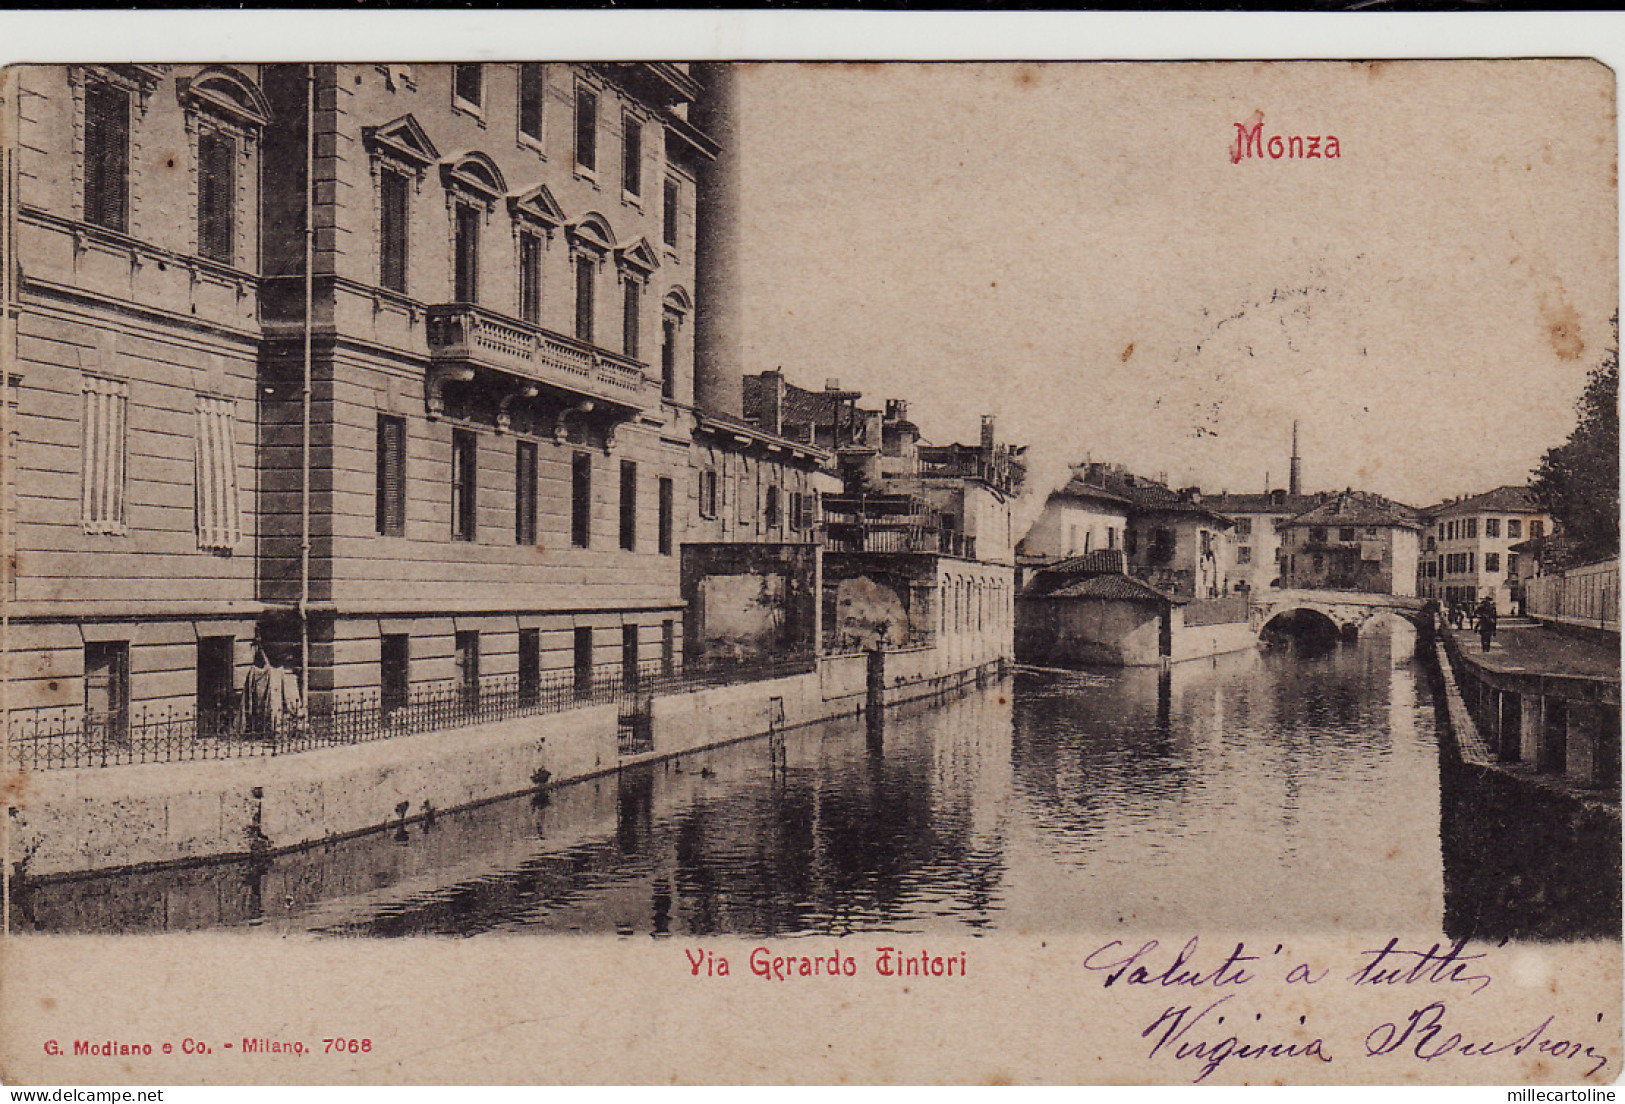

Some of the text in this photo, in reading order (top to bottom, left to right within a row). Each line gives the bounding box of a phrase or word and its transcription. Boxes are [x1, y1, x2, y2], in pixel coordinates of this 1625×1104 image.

[1231, 121, 1341, 164] Monza
[685, 946, 967, 981] Via Gerardo Tintori
[1083, 935, 1263, 988] Saluti
[43, 1039, 64, 1056] G.
[73, 1040, 152, 1056] Modiano
[161, 1042, 173, 1055] e
[181, 1038, 213, 1055] Co.
[242, 1037, 310, 1056] Milano.
[322, 1037, 373, 1054] 7068
[1141, 995, 1333, 1084] Virginia
